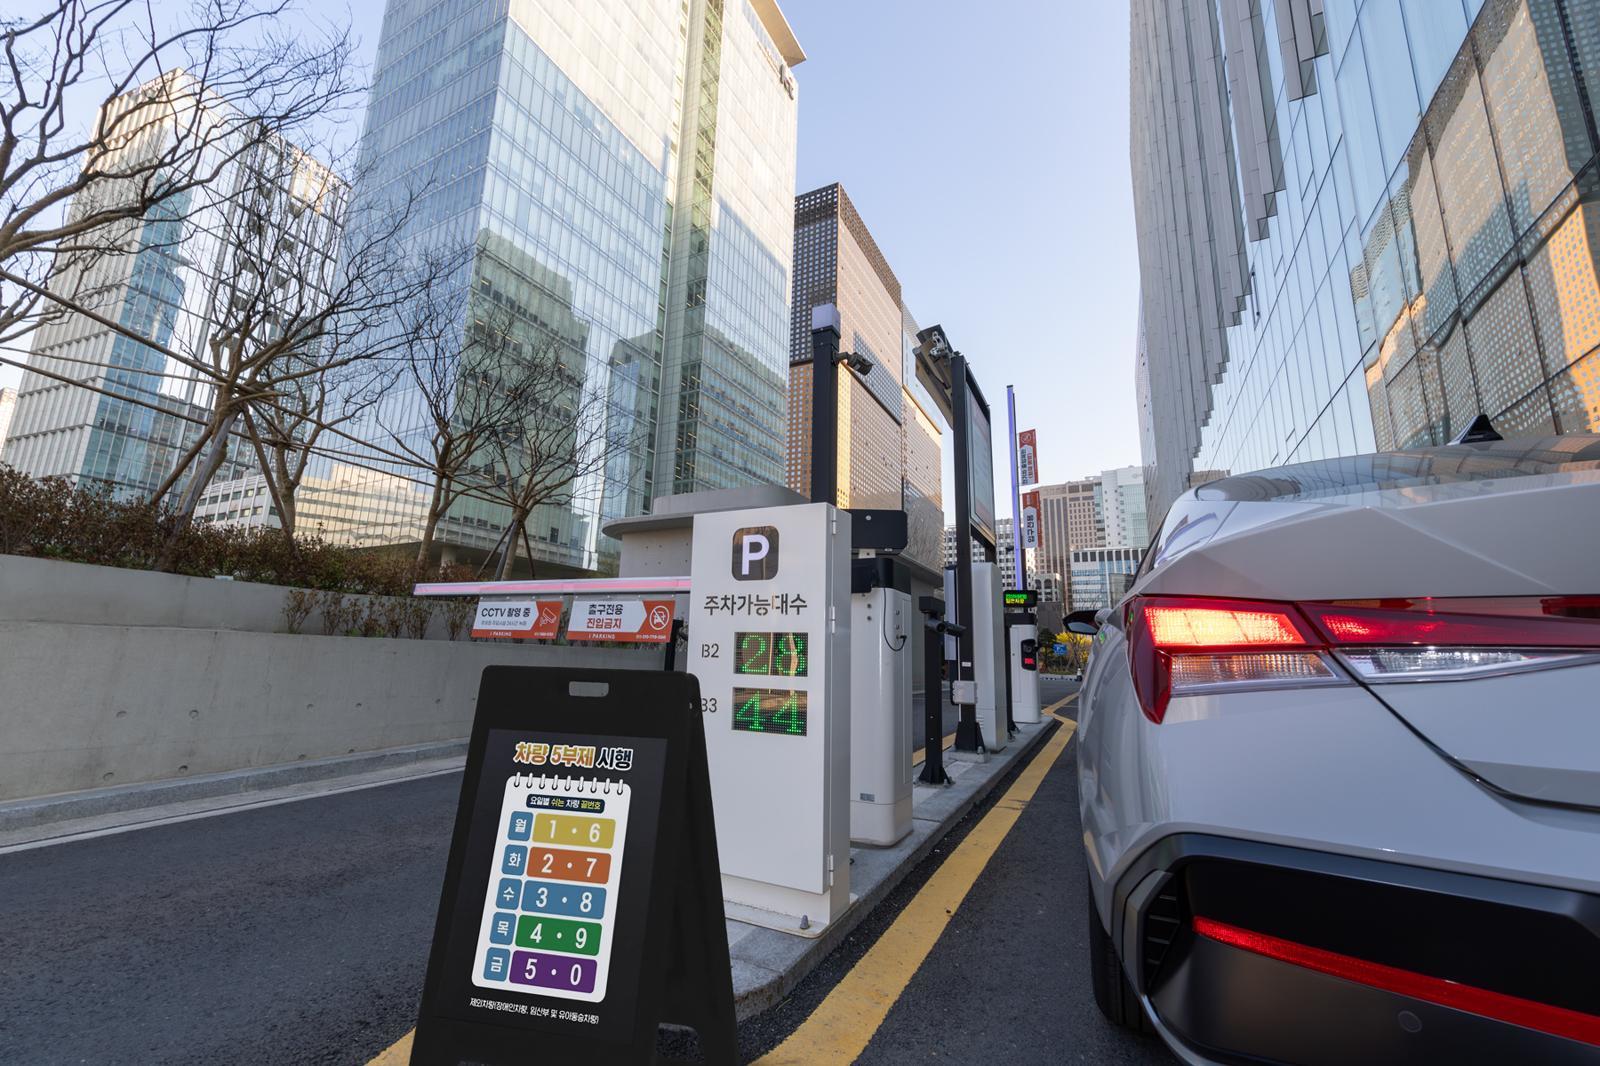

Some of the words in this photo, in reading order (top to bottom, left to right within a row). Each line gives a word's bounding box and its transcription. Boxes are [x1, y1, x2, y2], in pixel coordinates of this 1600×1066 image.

[741, 534, 770, 575] P
[481, 607, 506, 617] CCTV
[507, 607, 522, 617] 촬영
[523, 607, 531, 617] 중
[588, 604, 623, 615] 출구전용
[704, 593, 808, 616] 주차가능대수
[586, 617, 622, 629] 진입금지
[701, 643, 719, 658] B2
[741, 635, 805, 674] 28
[735, 690, 805, 733] 44
[513, 741, 549, 764] 차량
[550, 744, 596, 768] 5부제
[596, 747, 633, 771] 시행
[530, 796, 551, 806] 요일별
[551, 798, 565, 807] 쉬는
[565, 799, 580, 809] 차량
[515, 818, 527, 833] 월
[508, 852, 521, 868] 화
[502, 886, 515, 901] 수
[498, 920, 509, 936] 목
[490, 956, 503, 973] 금
[530, 1006, 550, 1017] 임산부
[550, 1009, 558, 1018] 및
